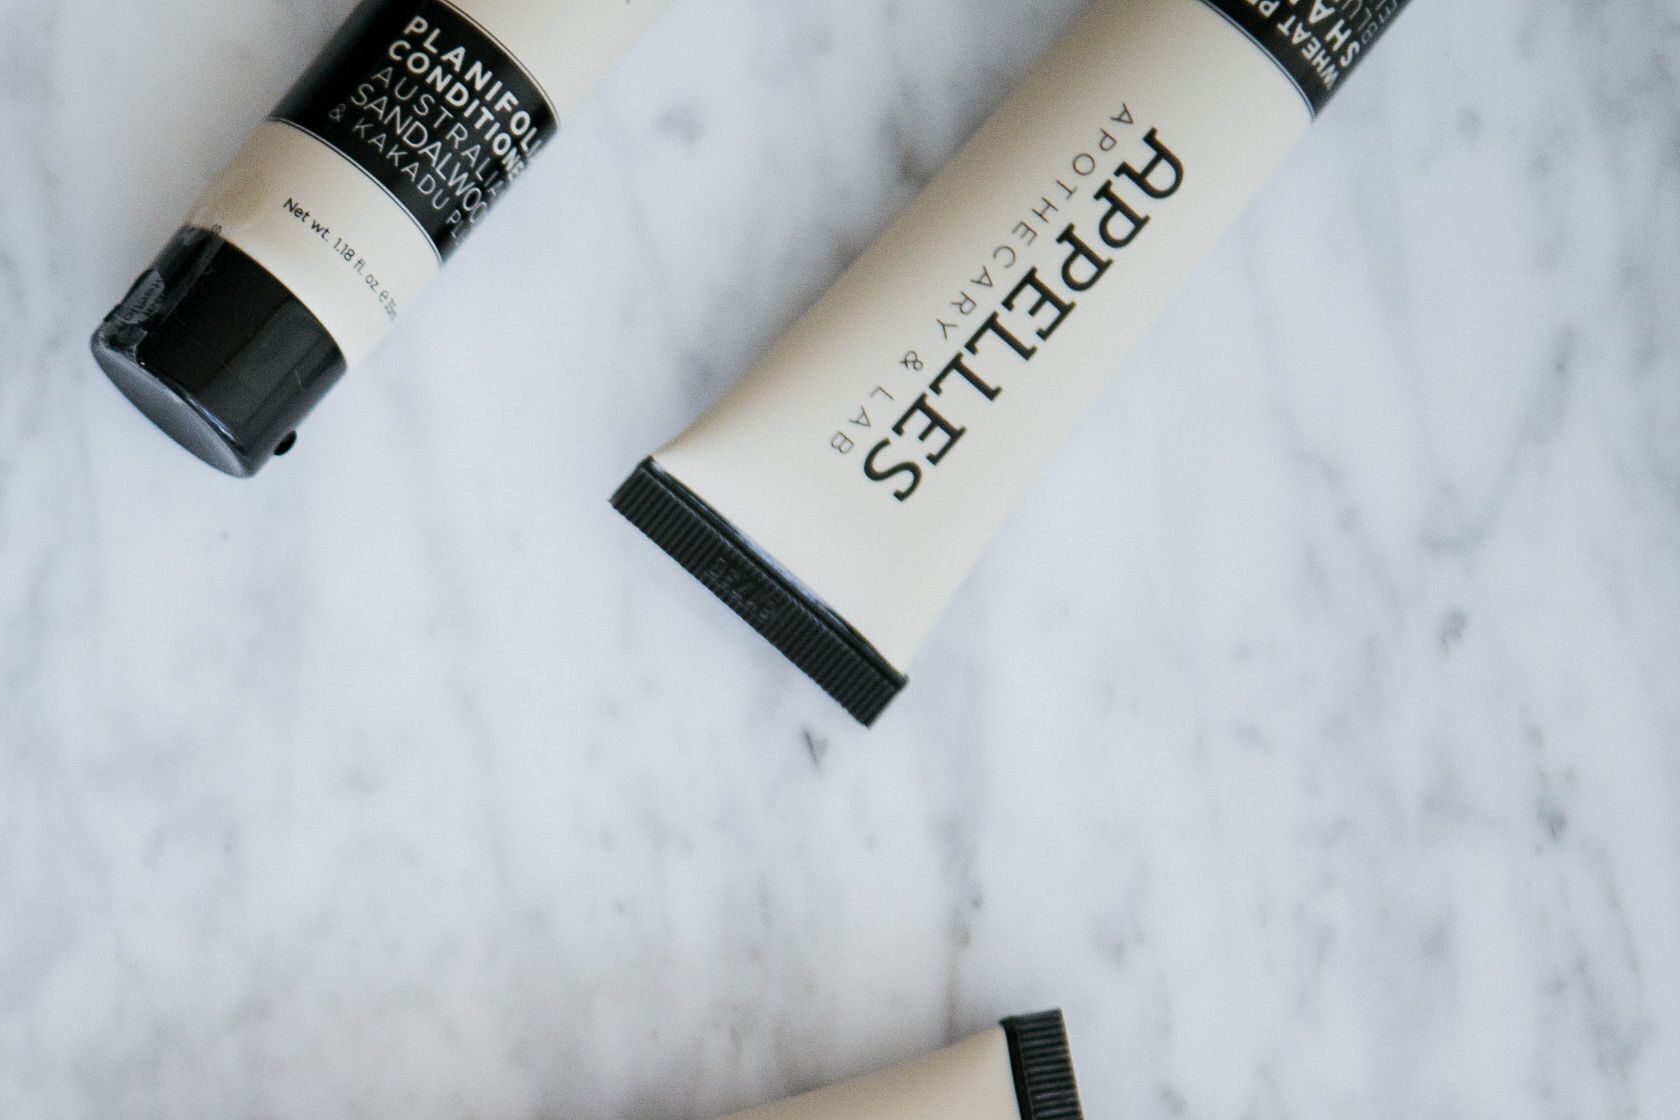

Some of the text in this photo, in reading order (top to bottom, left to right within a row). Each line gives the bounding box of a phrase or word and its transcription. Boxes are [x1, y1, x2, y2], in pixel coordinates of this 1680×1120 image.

[1276, 15, 1340, 90] WHEAT
[1290, 0, 1361, 67] SHA
[329, 103, 346, 122] &
[352, 117, 450, 210] KAKADU
[283, 197, 310, 222] Net
[311, 219, 331, 242] wt.
[332, 238, 356, 262] 1.18
[353, 258, 367, 275] fl.
[829, 102, 1135, 455] APOTHECARY & LAB
[863, 127, 1185, 502] APPELLES
